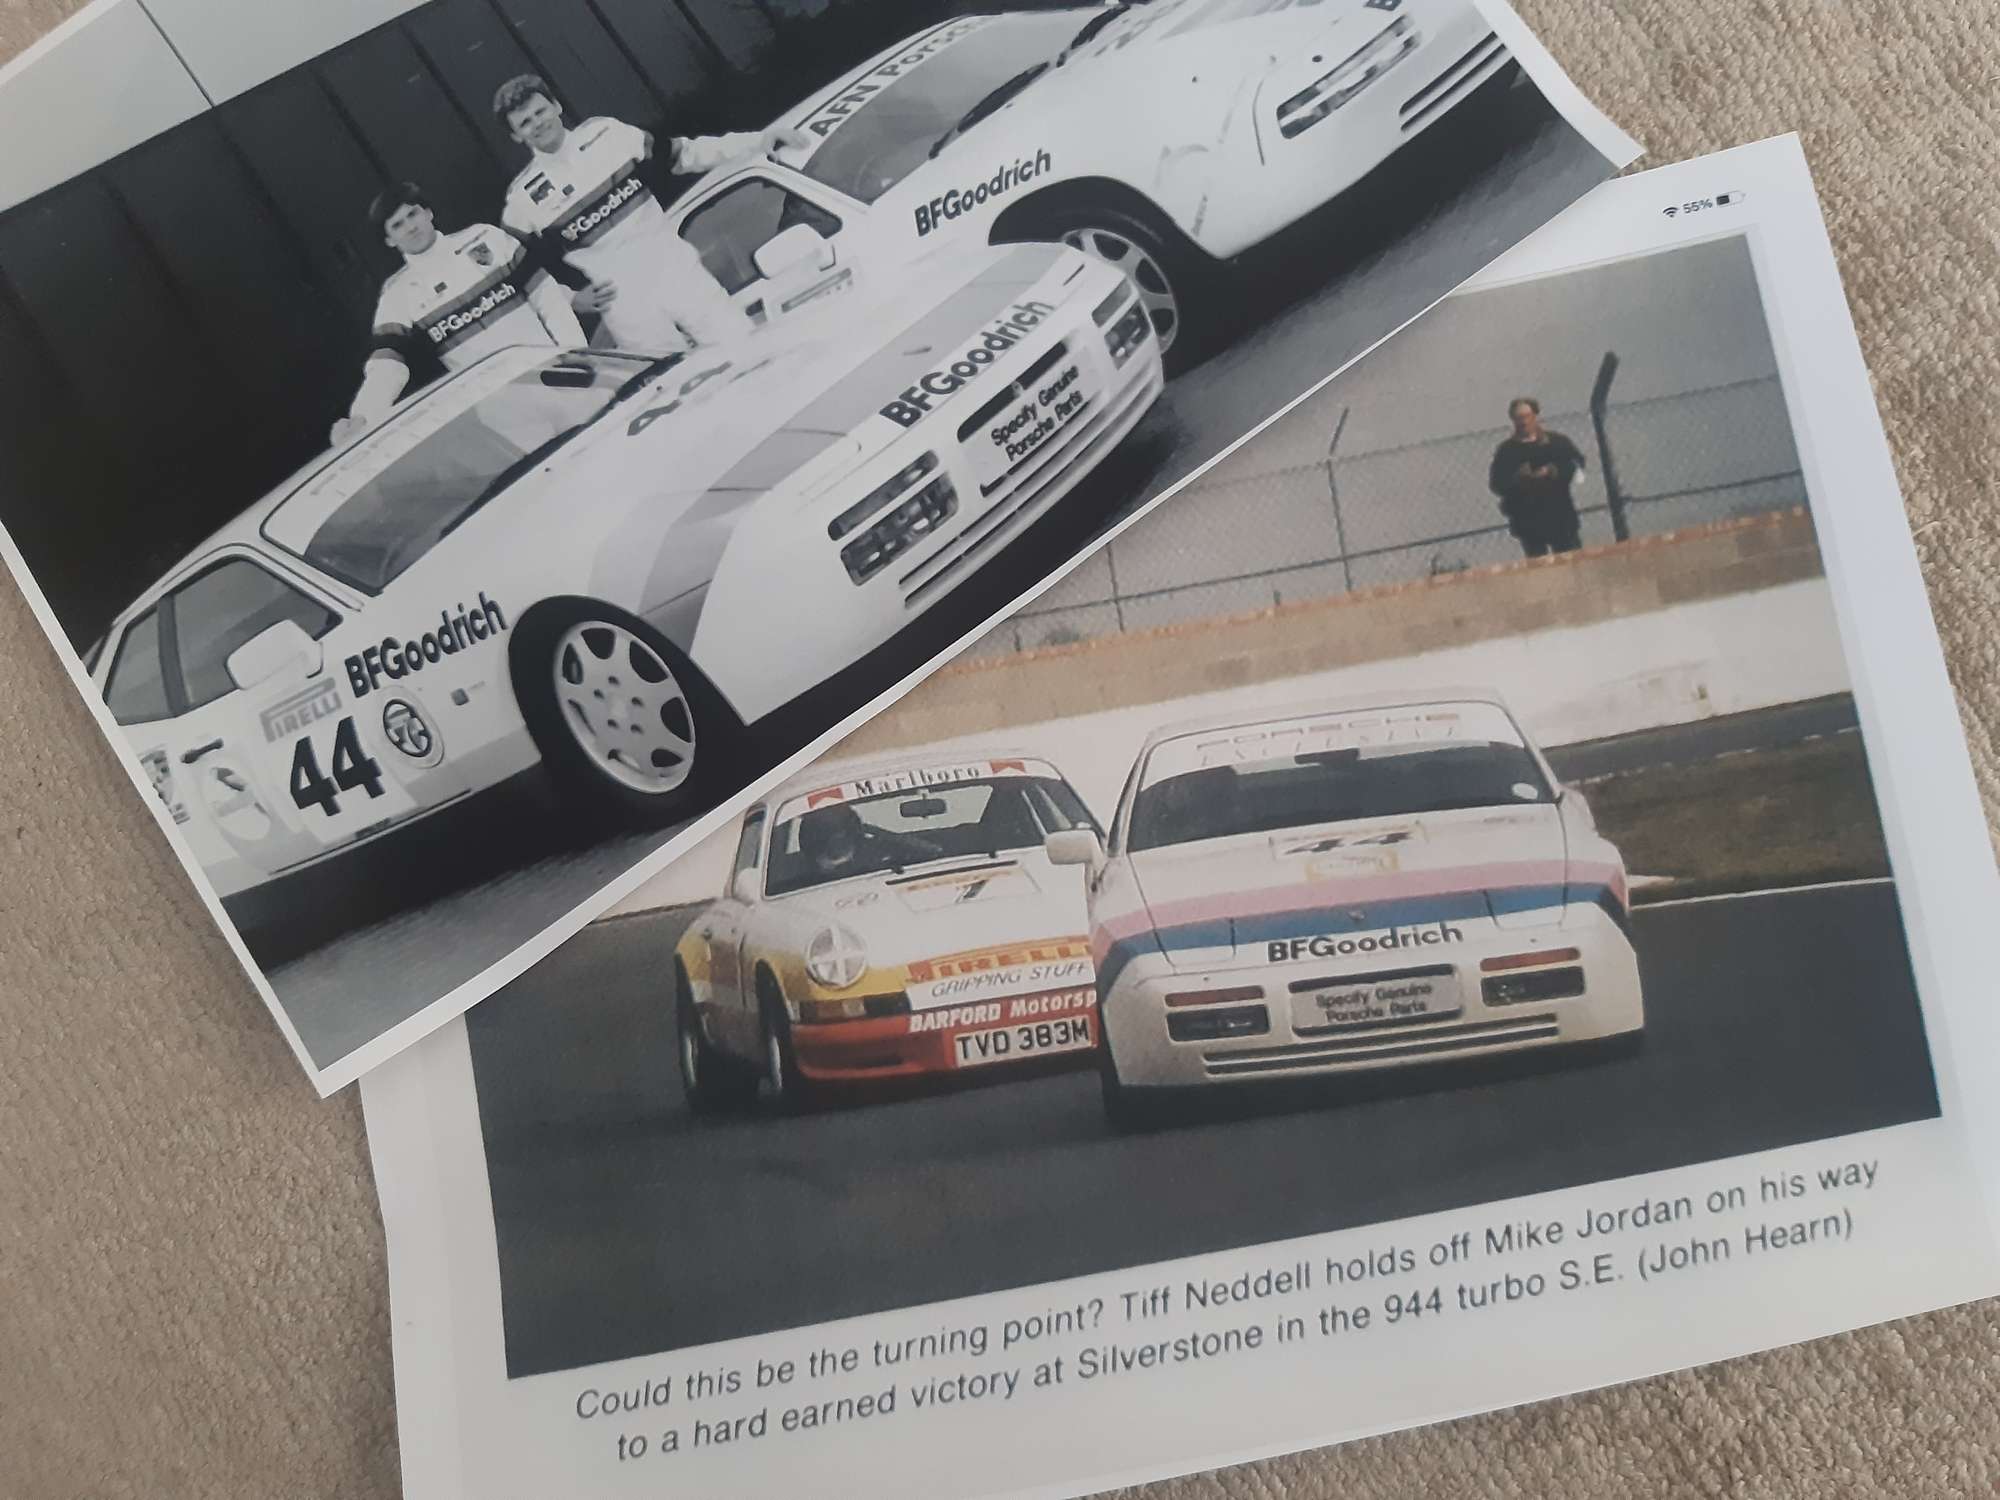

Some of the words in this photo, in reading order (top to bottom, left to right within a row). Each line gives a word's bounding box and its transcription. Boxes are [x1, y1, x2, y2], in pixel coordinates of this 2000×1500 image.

[809, 84, 880, 136] AFN
[561, 177, 643, 241] BFGoodrich
[914, 149, 1051, 238] BFGoodrich
[1683, 198, 1713, 214] 55%
[427, 283, 516, 343] BFGoodrich
[879, 300, 1055, 428] BFGoodrich
[991, 403, 1037, 446] Specify
[1005, 416, 1055, 461] Porsche
[1055, 390, 1083, 421] Parts
[344, 591, 508, 698] BFGoodrich
[260, 677, 342, 743] PIRELLI
[290, 716, 386, 816] 44
[854, 765, 980, 797] Marlboro
[1267, 920, 1464, 963] BFGoodrich
[931, 969, 1022, 998] GRIPPING
[1029, 961, 1088, 982] STUFF
[909, 1003, 1001, 1033] BARFORD
[955, 1030, 1010, 1060] TVD
[1018, 1018, 1089, 1051] 383M
[576, 1377, 672, 1420] Could
[686, 1369, 742, 1401] this
[755, 1358, 795, 1388] be
[809, 1348, 859, 1379] the
[873, 1324, 989, 1368] turning
[1002, 1297, 1104, 1352] point?
[1120, 1285, 1171, 1322] Tiff
[1185, 1260, 1311, 1310] Neddell
[1325, 1246, 1416, 1287] holds
[1428, 1231, 1470, 1267] off
[1485, 1218, 1564, 1256] Mike
[1576, 1195, 1693, 1240] Jordan
[1706, 1186, 1746, 1214] on
[1760, 1171, 1806, 1203] his
[1817, 1159, 1880, 1189] way
[617, 1433, 648, 1462] to
[661, 1430, 679, 1454] a
[693, 1408, 768, 1449] hard
[781, 1385, 897, 1433] earned
[911, 1366, 1020, 1408] victory
[1033, 1357, 1064, 1389] at
[1077, 1322, 1264, 1380] Silverstone
[1276, 1315, 1305, 1345] in
[1319, 1297, 1372, 1337] the
[1384, 1285, 1443, 1324] 944
[1457, 1273, 1546, 1311] turbo
[1558, 1253, 1624, 1292] S.E.
[1638, 1236, 1731, 1281] (John
[1744, 1207, 1853, 1255] Hearn)
